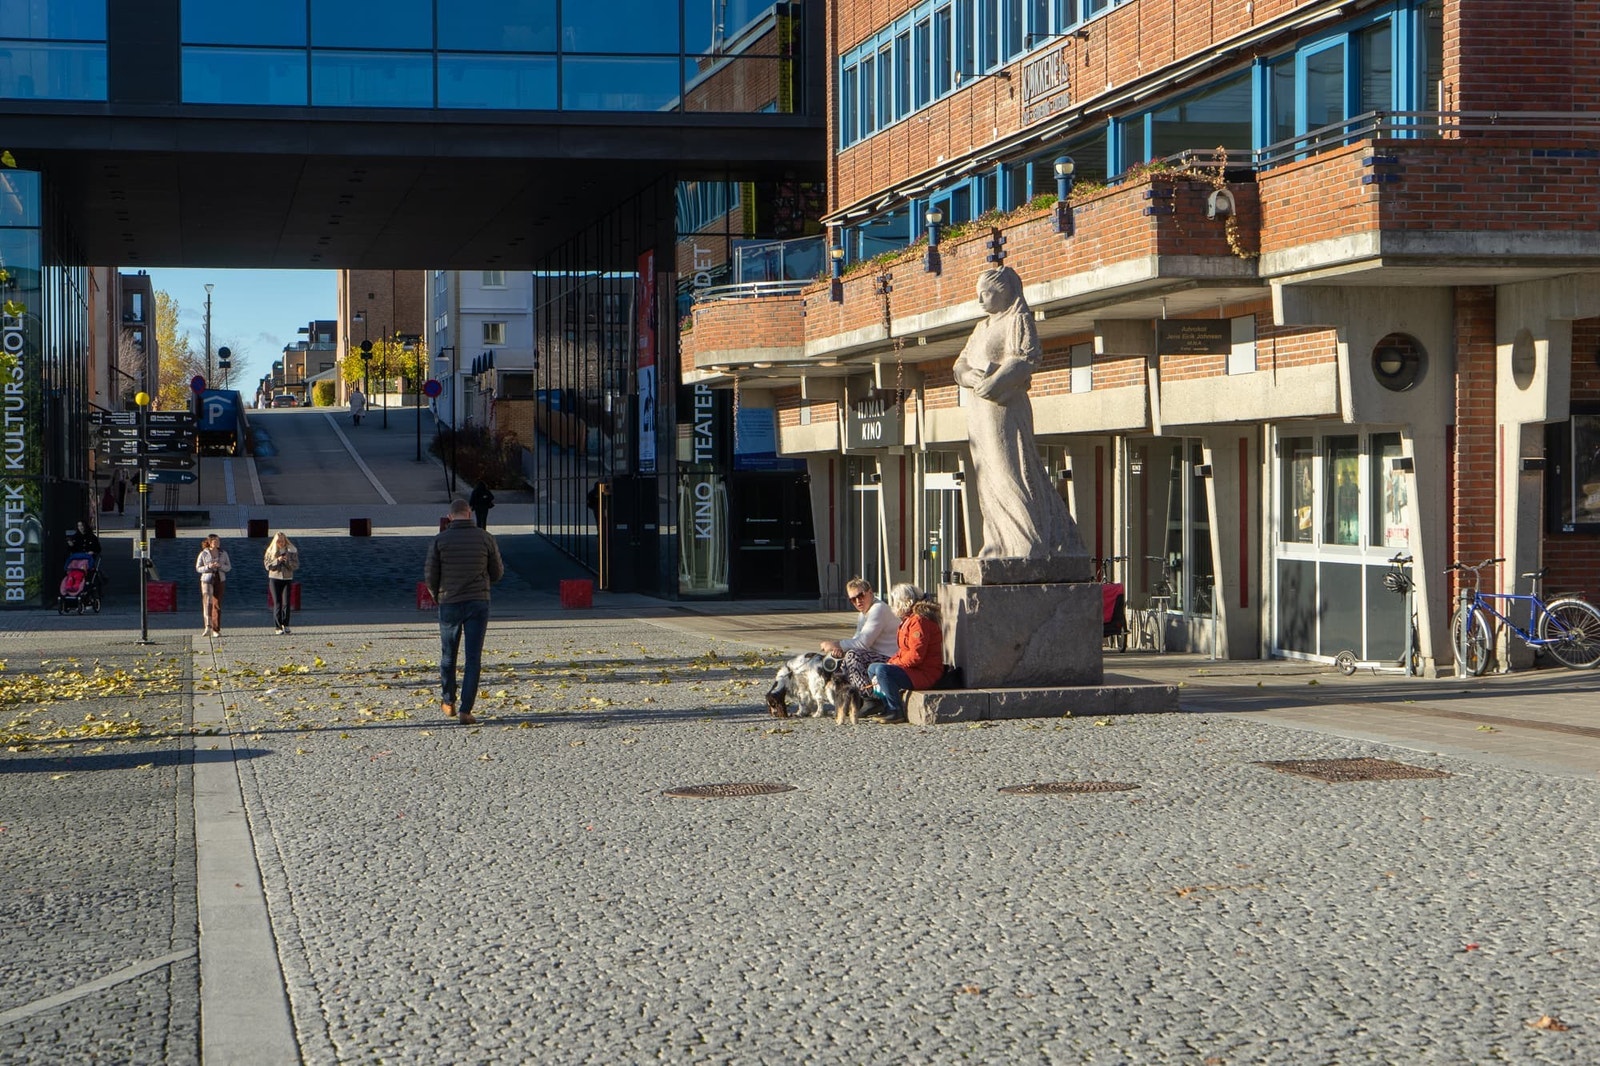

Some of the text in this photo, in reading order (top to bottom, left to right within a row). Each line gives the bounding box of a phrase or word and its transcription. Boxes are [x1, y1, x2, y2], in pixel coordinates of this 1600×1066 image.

[209, 403, 224, 424] P
[695, 383, 713, 464] TEATER
[862, 421, 882, 440] KINO
[695, 482, 713, 538] KINO
[5, 484, 25, 601] BIBLIOTEK
